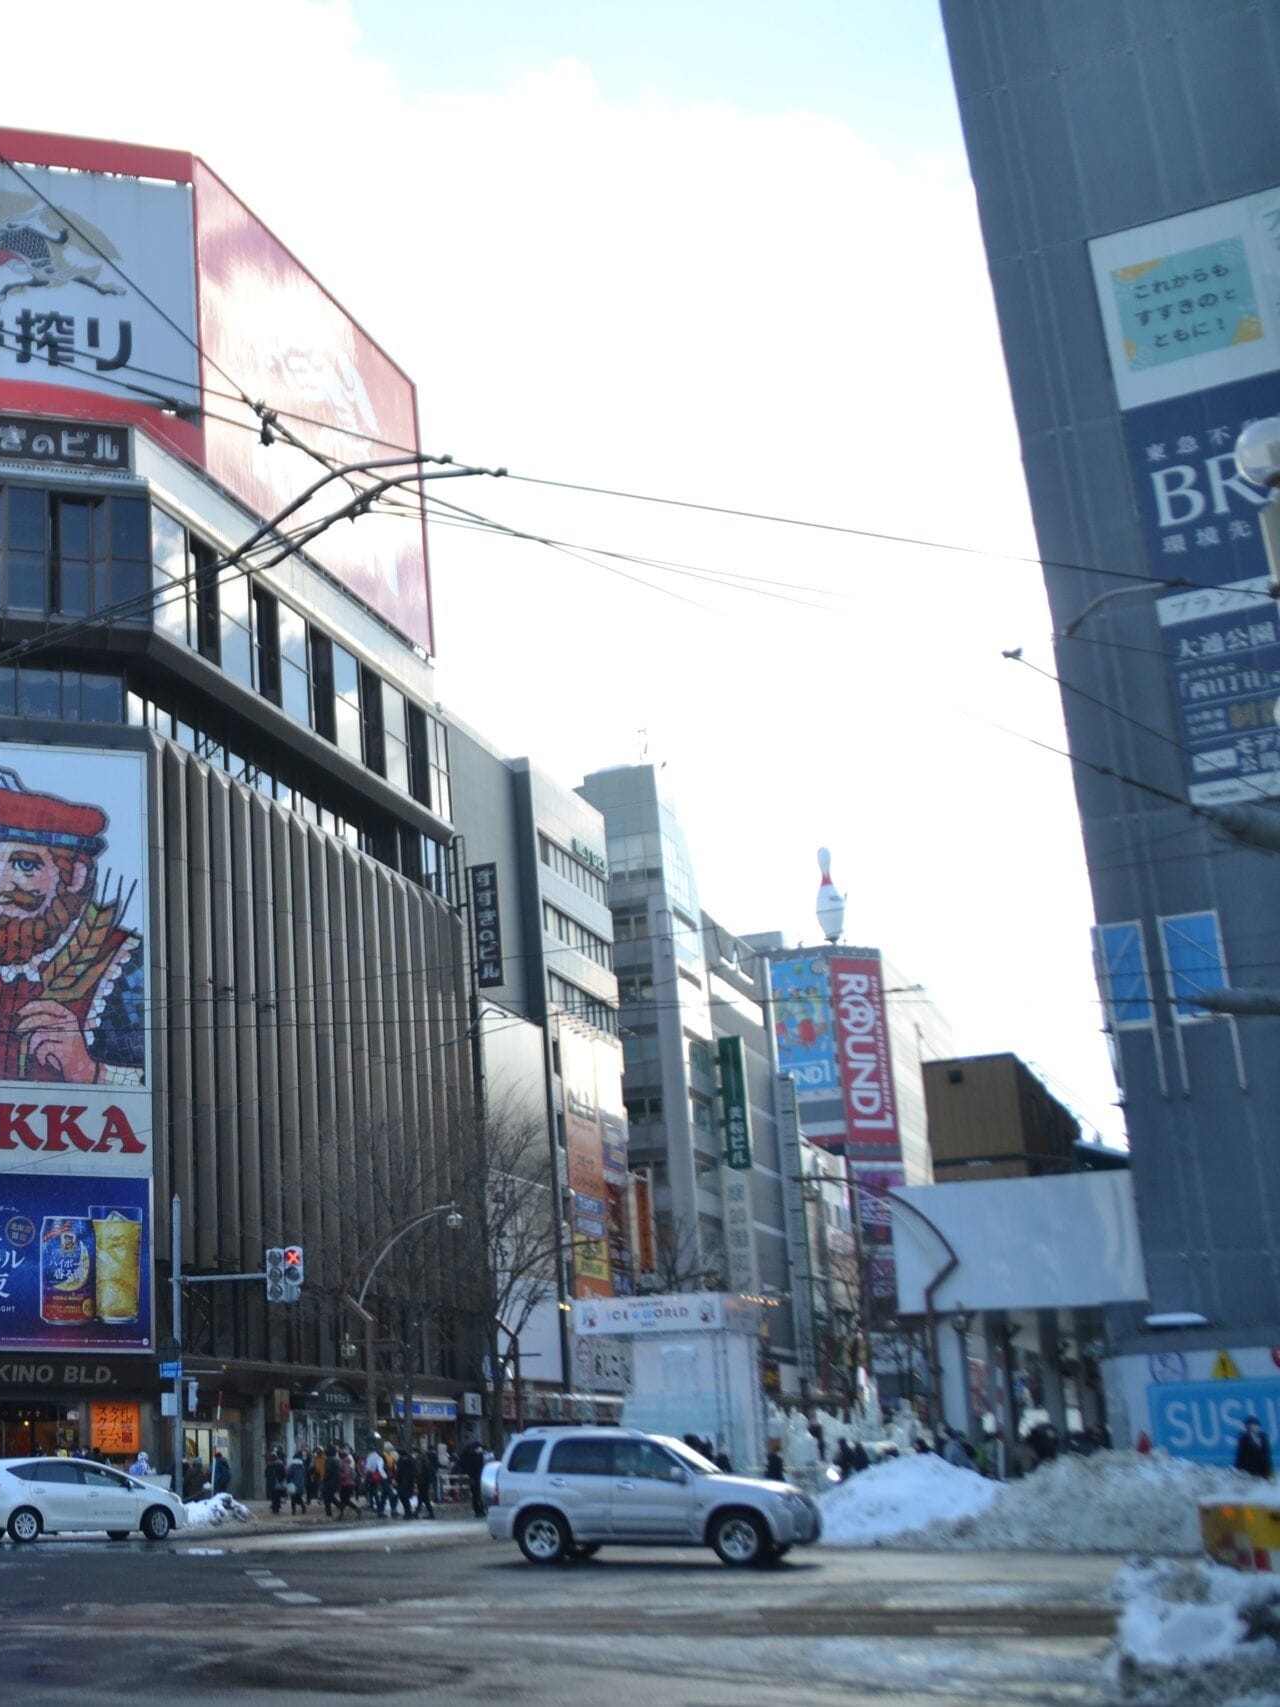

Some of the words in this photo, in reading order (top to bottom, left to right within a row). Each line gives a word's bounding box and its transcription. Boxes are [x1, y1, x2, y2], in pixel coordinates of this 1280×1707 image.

[1135, 263, 1230, 300] これからも
[1134, 288, 1237, 326] すすきのと
[475, 868, 499, 979] すすきのビル
[838, 973, 895, 1129] ROUND1
[63, 1365, 118, 1384] BLD.
